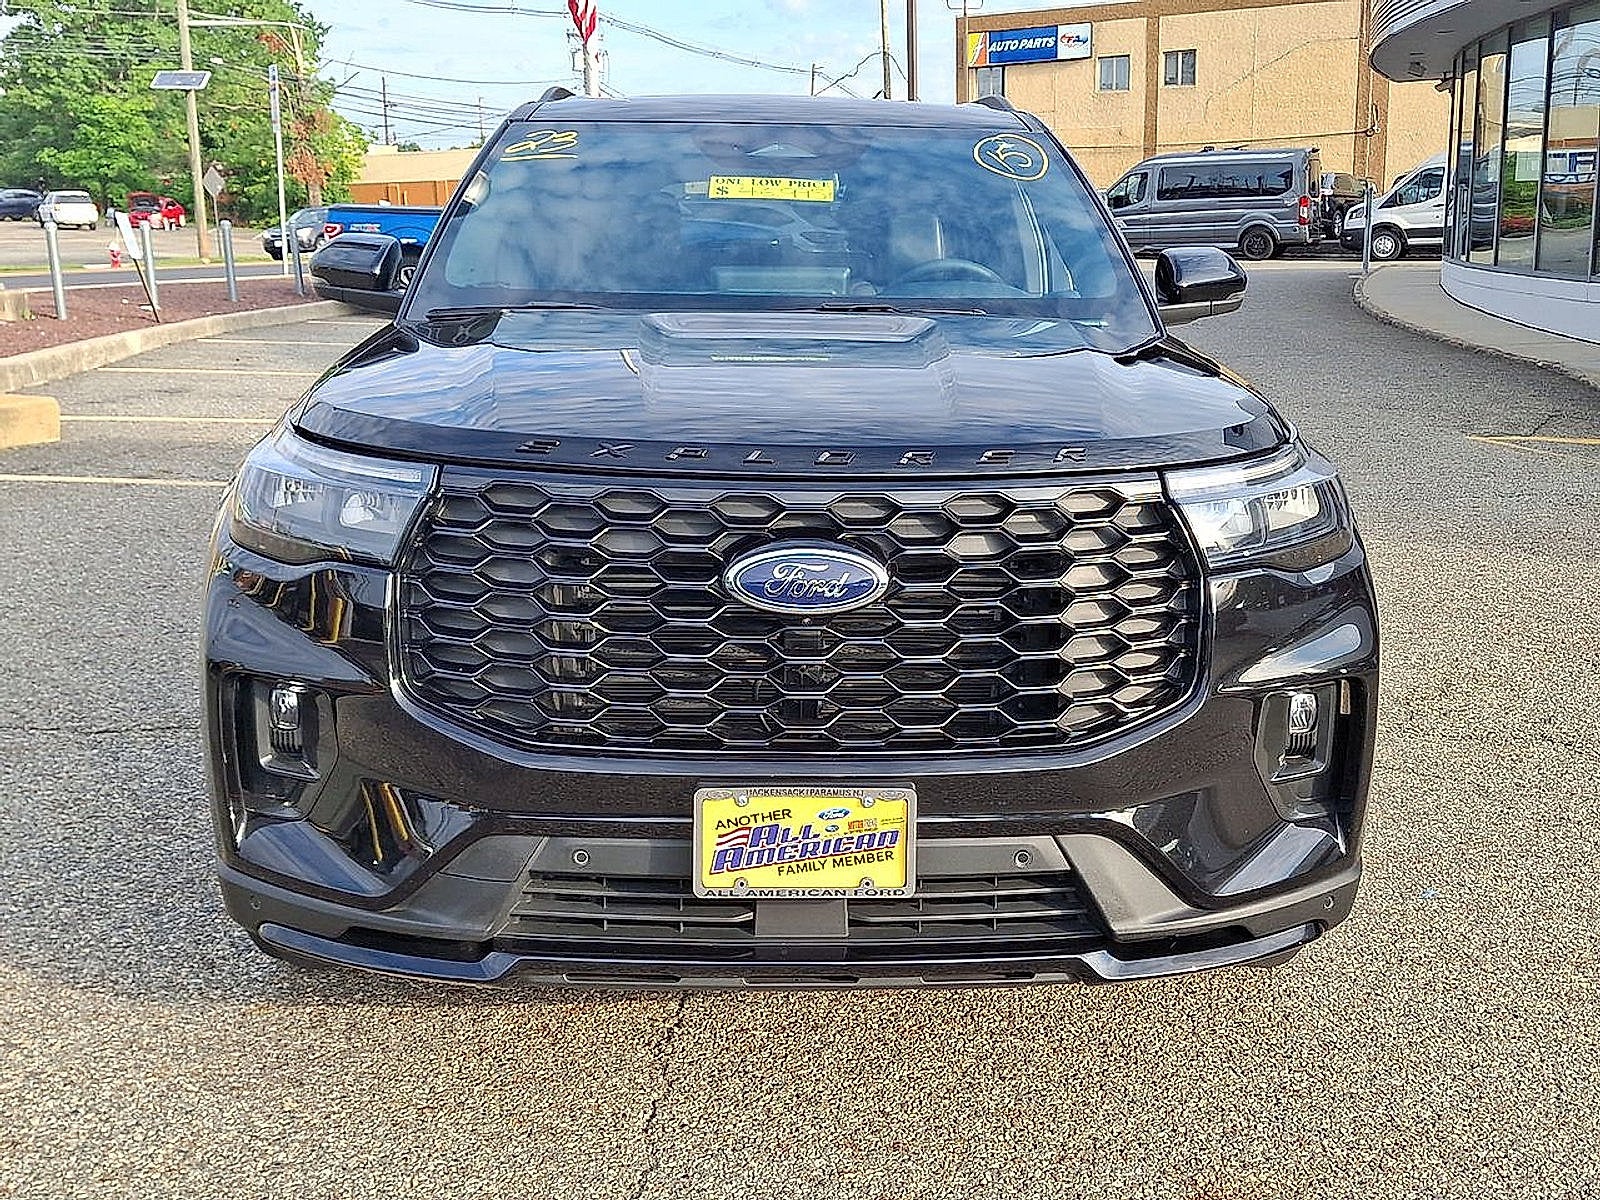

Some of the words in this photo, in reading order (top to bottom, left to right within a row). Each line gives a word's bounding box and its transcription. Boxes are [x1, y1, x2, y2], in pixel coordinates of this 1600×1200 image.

[988, 39, 1019, 53] AUTO
[1019, 35, 1056, 50] PARTS
[504, 129, 579, 154] 23
[751, 179, 782, 187] LOW
[515, 439, 1088, 466] EXPLORER
[764, 562, 850, 599] Ford
[715, 808, 792, 831] ANOTHER
[750, 824, 820, 848] ALL
[710, 830, 899, 874] AMERICAN
[777, 859, 827, 877] FAMILY
[832, 850, 895, 869] MEMBER
[705, 889, 734, 897] ALL
[749, 889, 846, 897] AMERICAN
[853, 889, 905, 897] FORD
